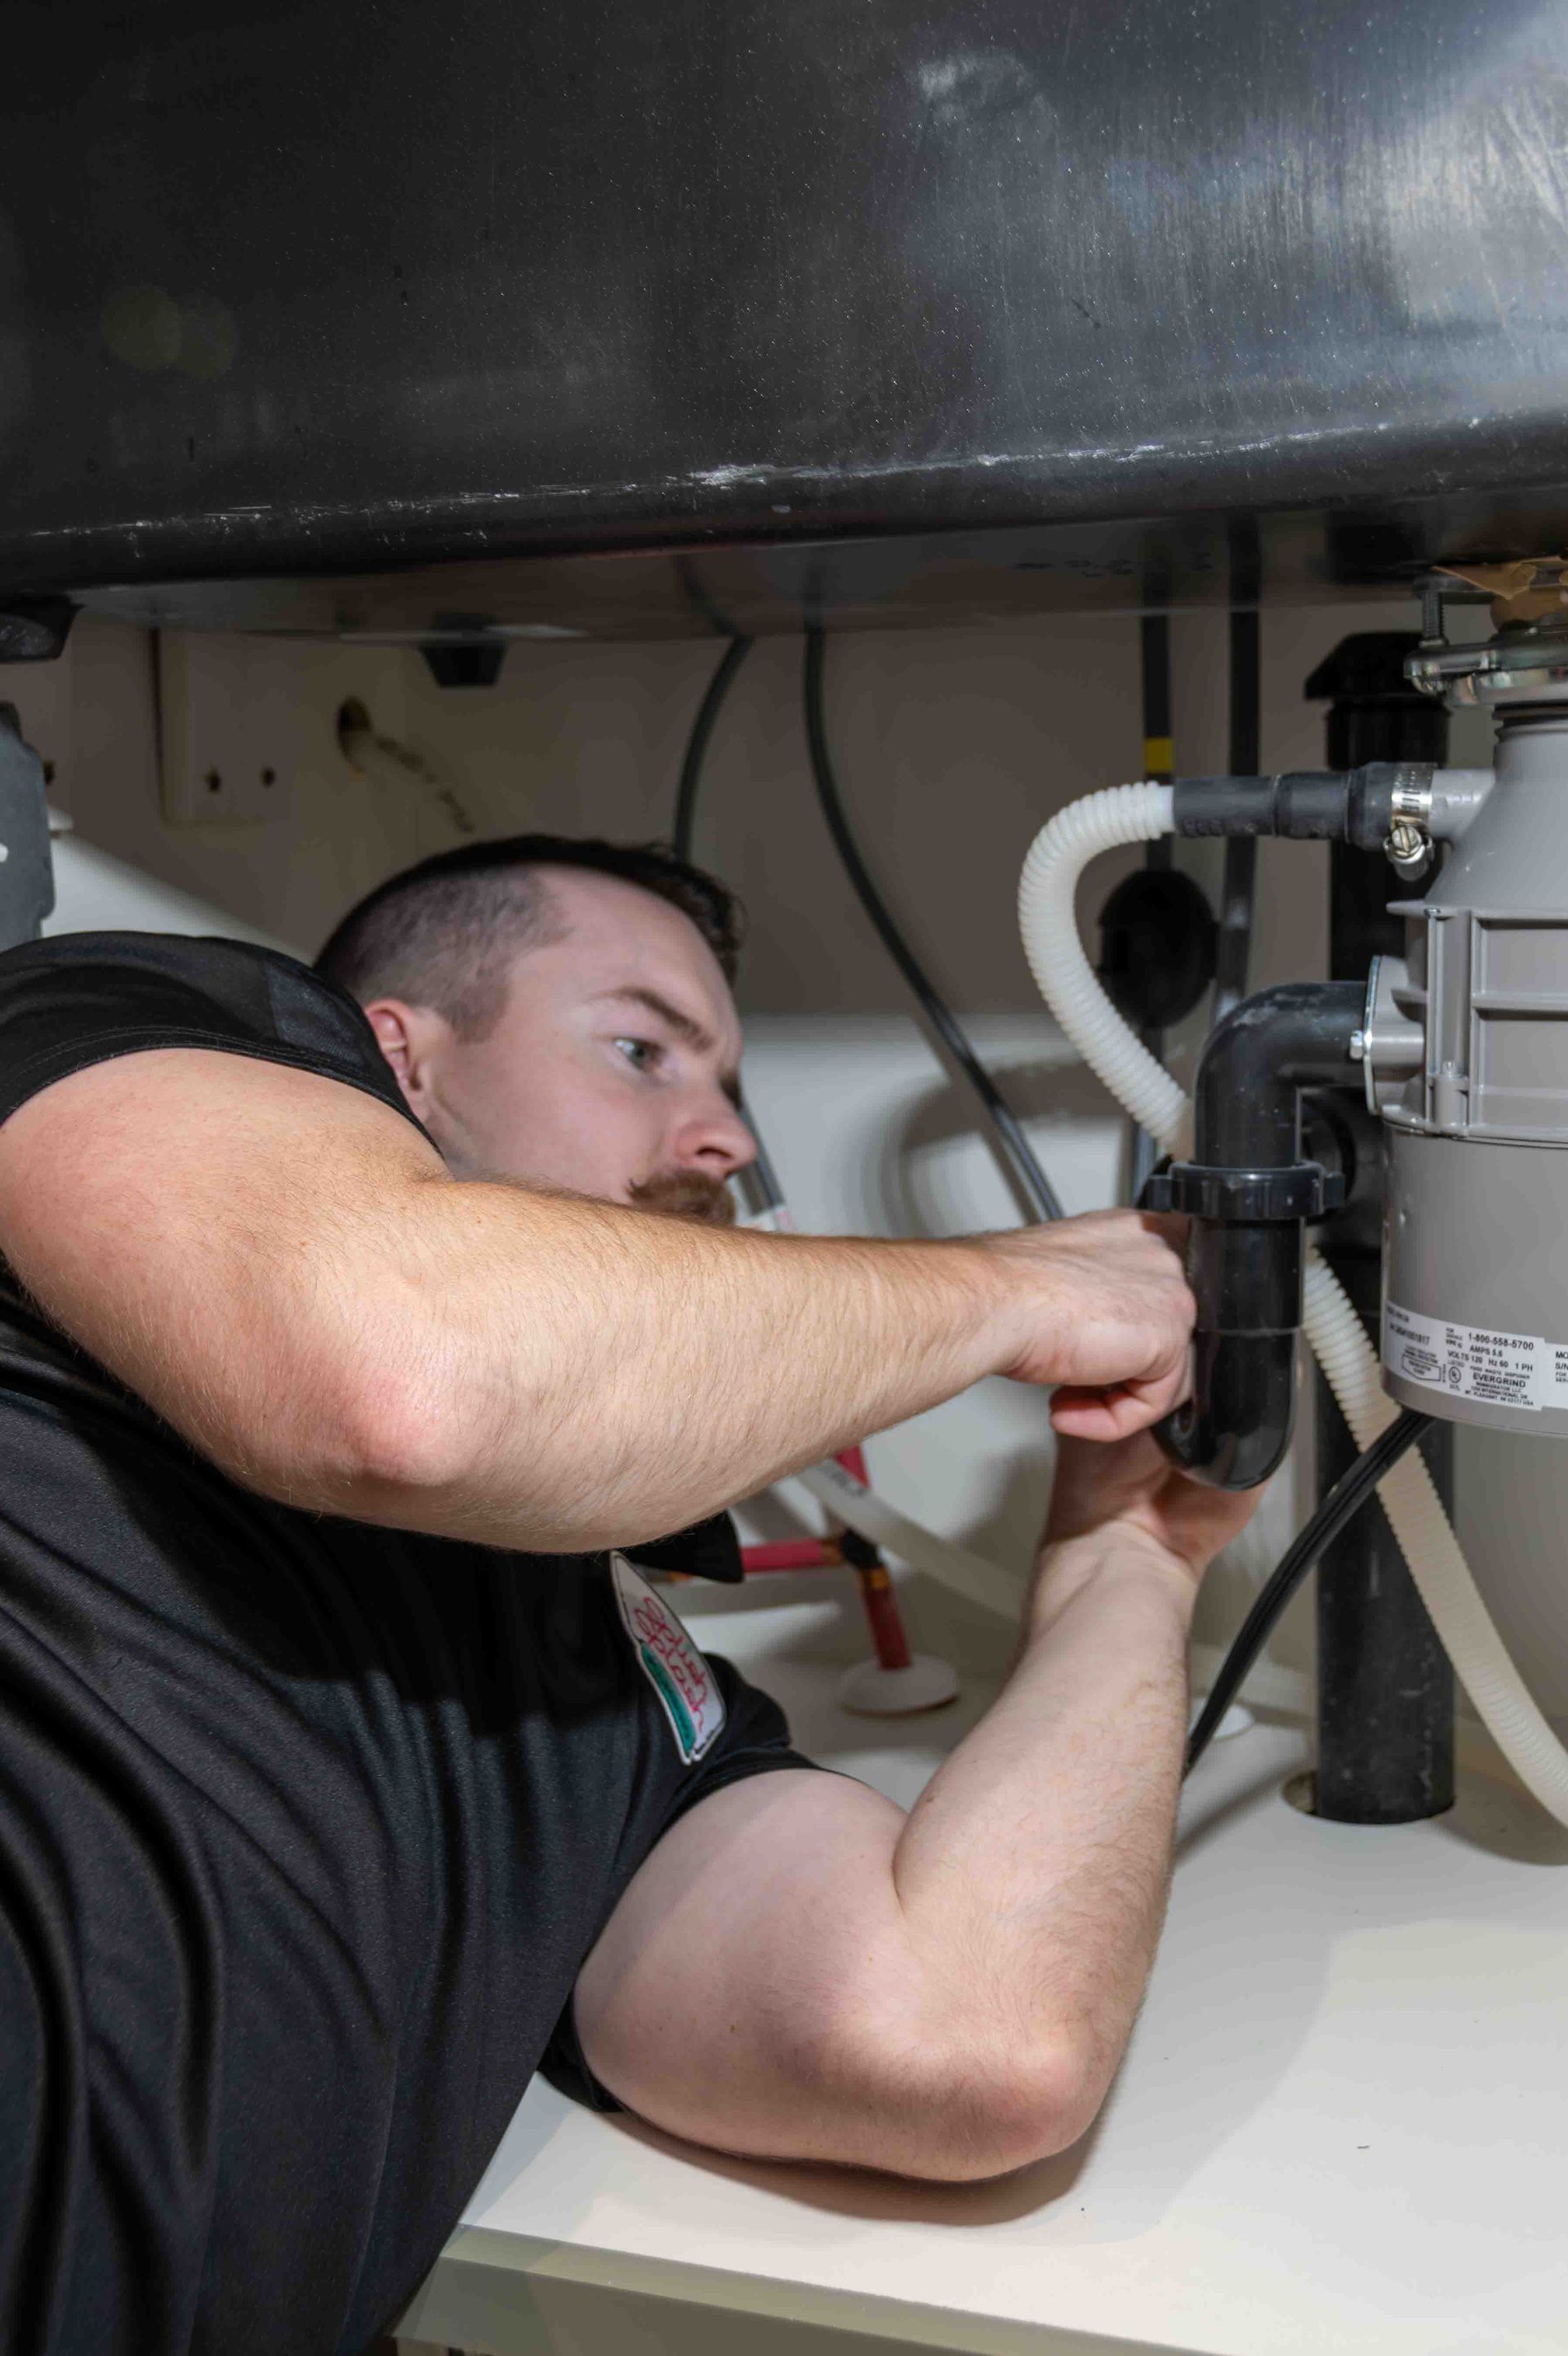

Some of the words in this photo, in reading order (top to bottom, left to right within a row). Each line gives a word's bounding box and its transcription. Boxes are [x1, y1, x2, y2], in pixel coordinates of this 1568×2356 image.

[1468, 1332, 1534, 1350] 1-800-558-5700
[1470, 1345, 1490, 1355] AMPS
[1447, 1350, 1469, 1361] VOLTS
[1471, 1355, 1483, 1363] 120
[1499, 1360, 1508, 1368] 60
[1521, 1363, 1533, 1372] PH
[1472, 1372, 1526, 1388] EVERGRIND
